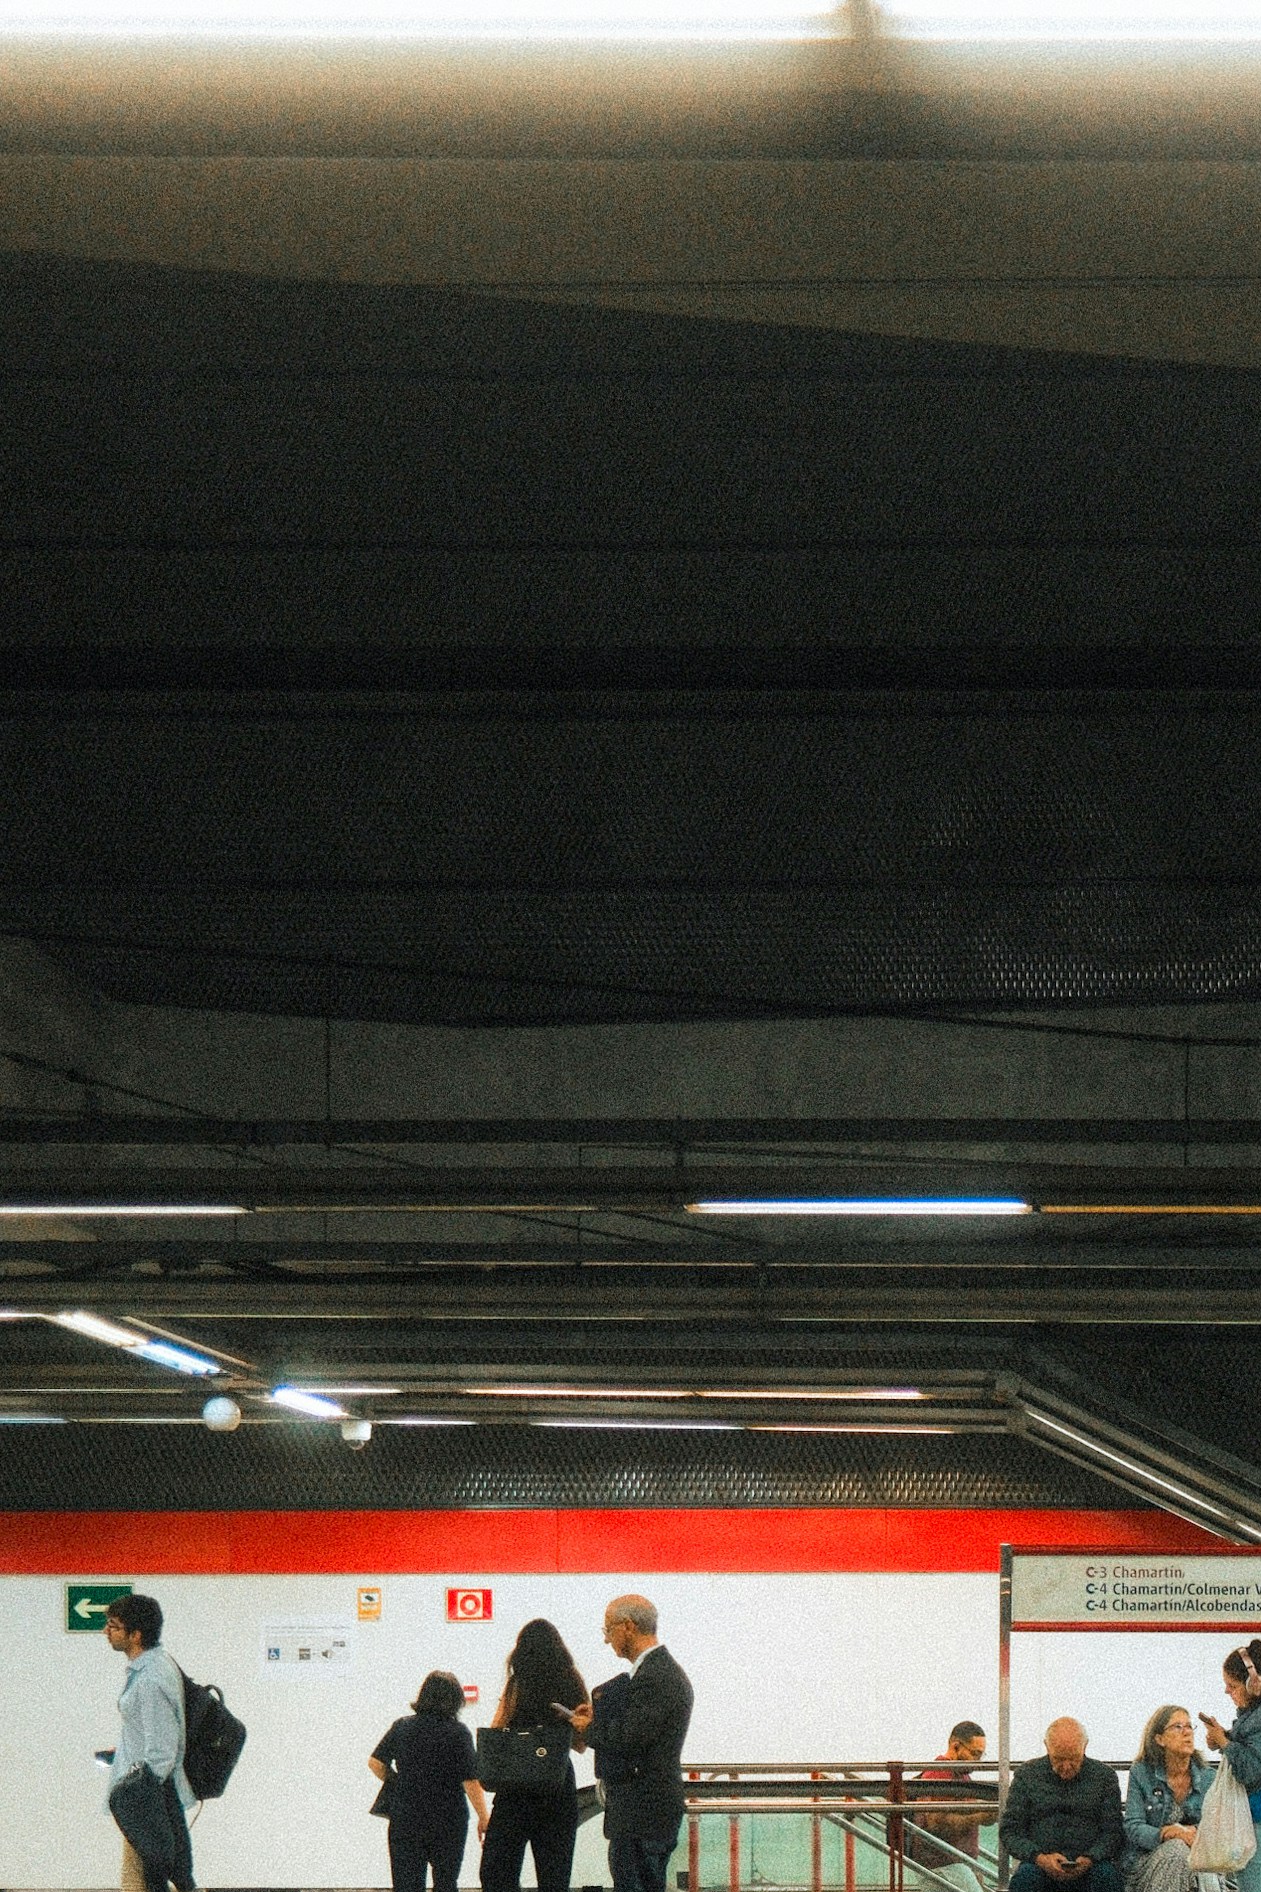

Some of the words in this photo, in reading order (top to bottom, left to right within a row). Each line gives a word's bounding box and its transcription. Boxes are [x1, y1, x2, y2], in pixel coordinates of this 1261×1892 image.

[1085, 1566, 1107, 1579] C-3
[1085, 1582, 1107, 1595] C-4
[1112, 1582, 1251, 1596] Chamartín/Colmenar
[1085, 1599, 1107, 1612] C-4
